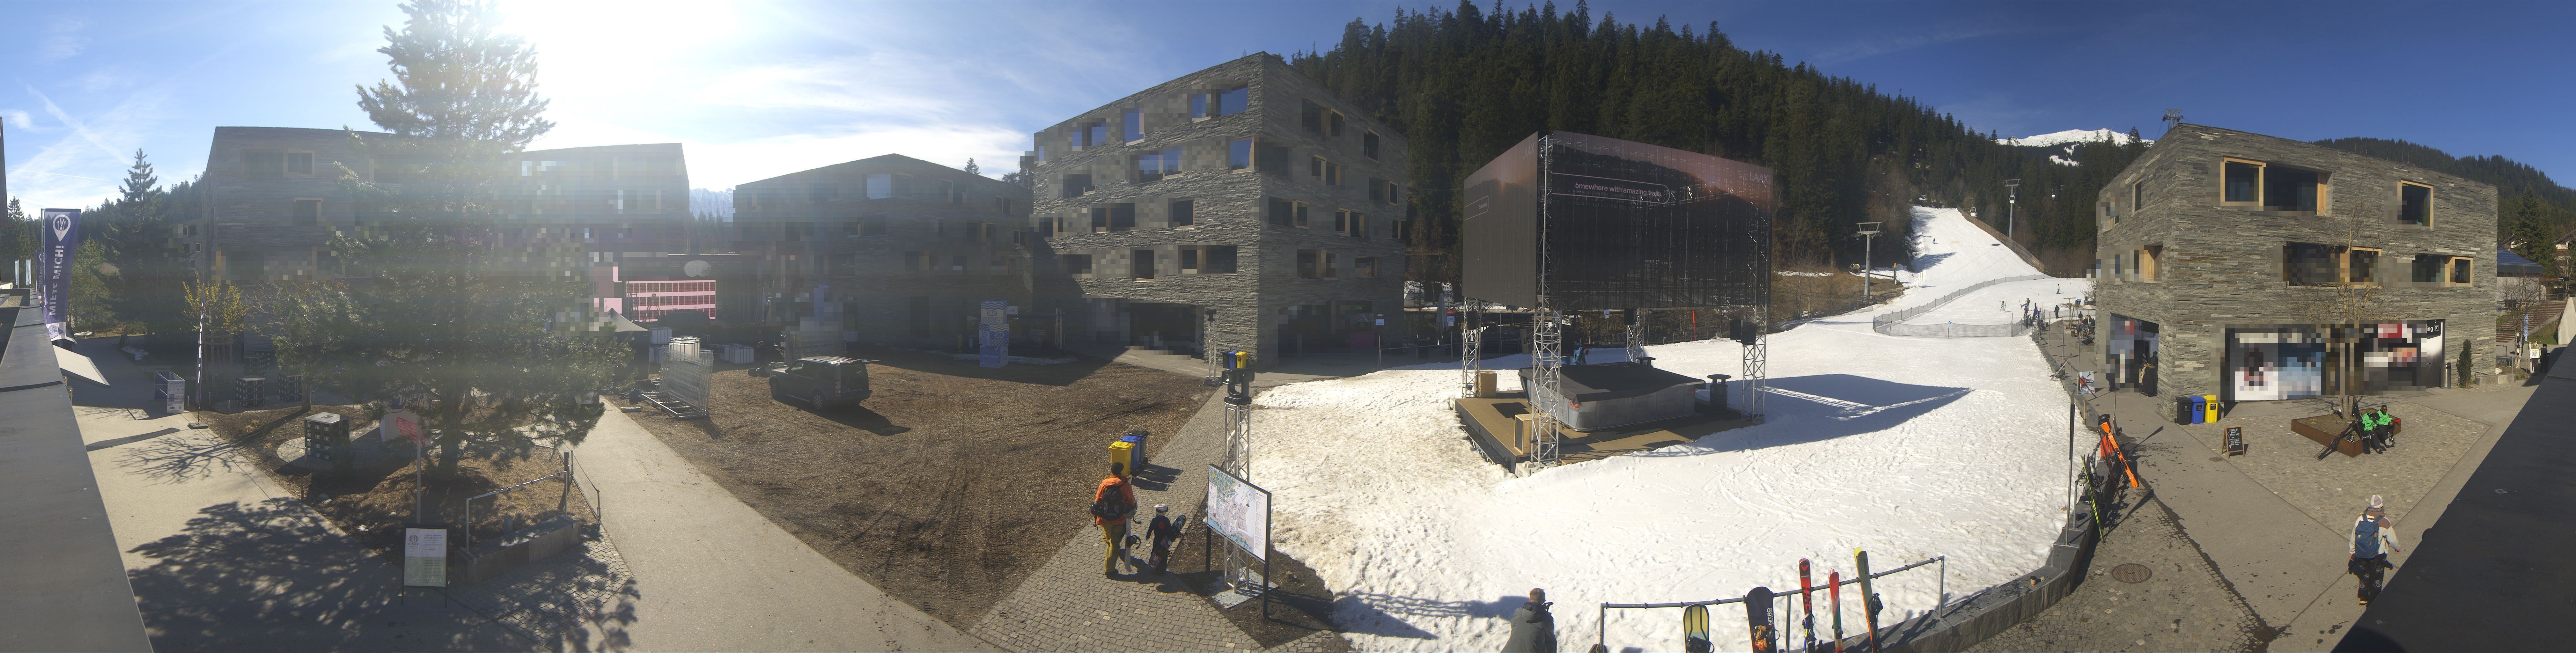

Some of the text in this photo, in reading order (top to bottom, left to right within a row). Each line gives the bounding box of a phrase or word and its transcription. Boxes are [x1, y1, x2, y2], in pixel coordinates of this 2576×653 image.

[1522, 143, 1535, 159] LAAX
[1750, 172, 1769, 184] LAAX
[1623, 187, 1647, 196] amazing
[53, 245, 64, 279] MICH!
